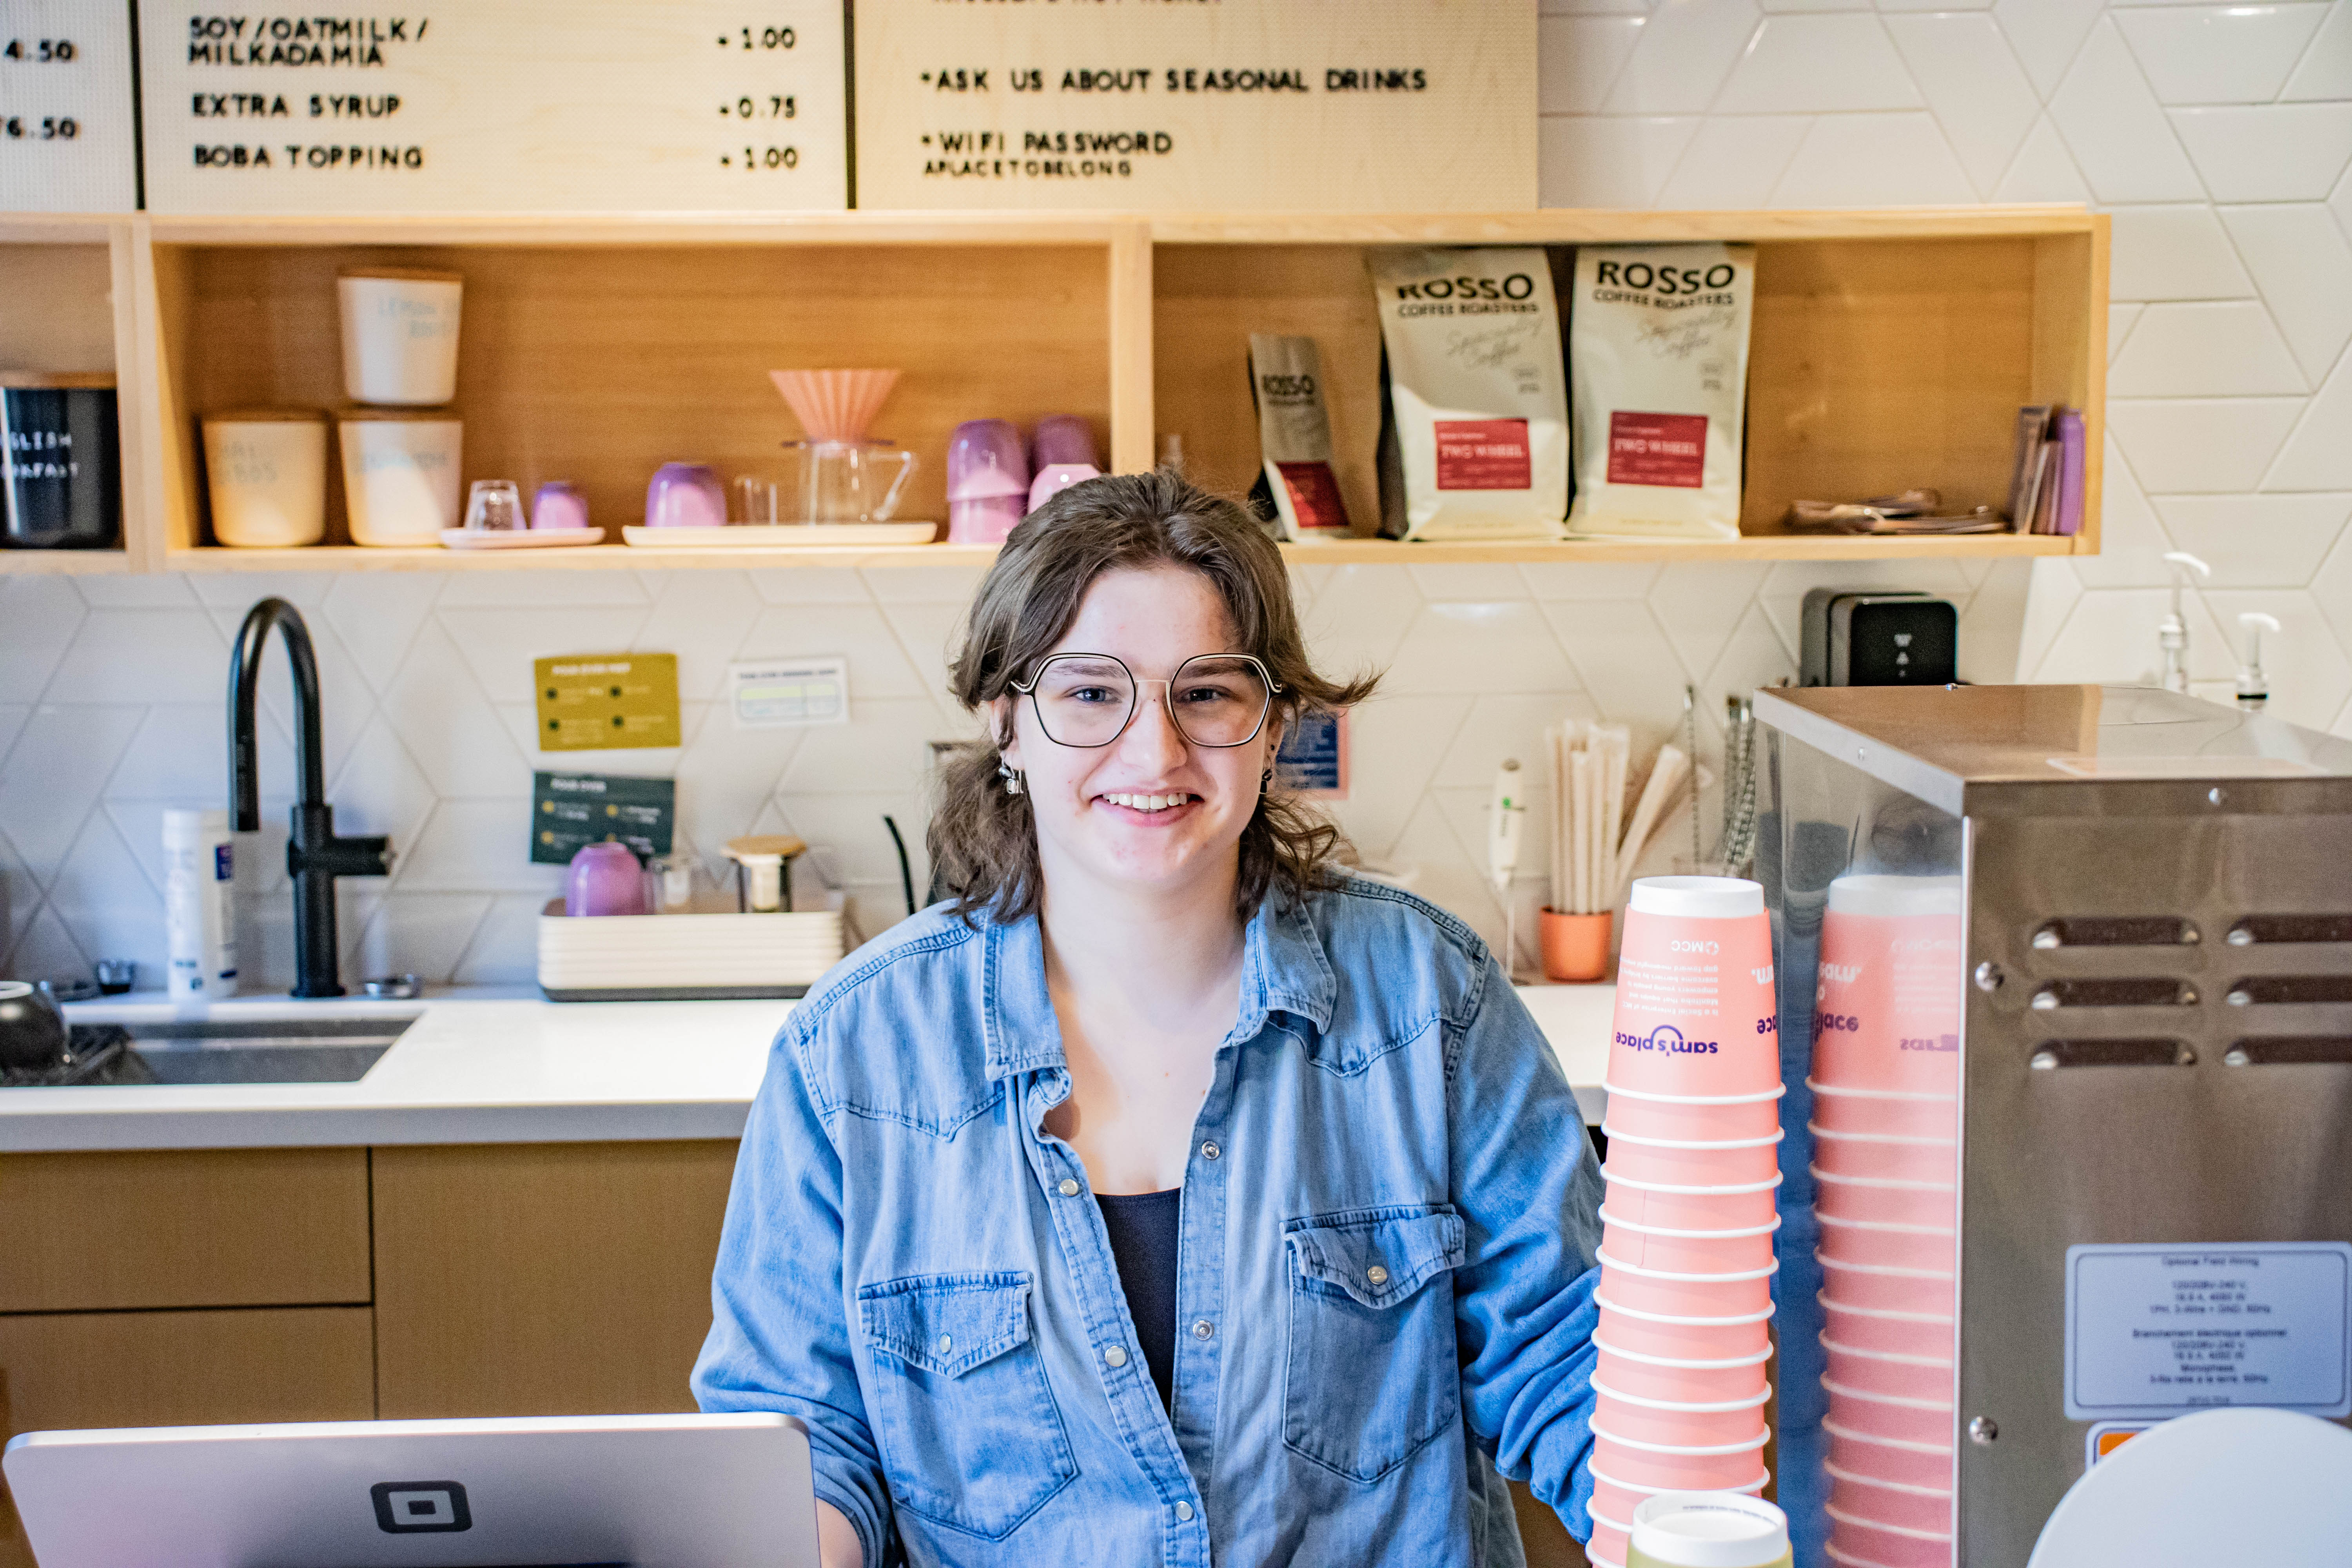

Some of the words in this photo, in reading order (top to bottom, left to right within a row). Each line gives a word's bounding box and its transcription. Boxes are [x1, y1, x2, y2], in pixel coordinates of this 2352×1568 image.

[189, 42, 384, 67] MILKADAMIA
[1011, 68, 1044, 91] US
[1062, 69, 1151, 92] ABOUT
[1165, 67, 1308, 92] SEASONAL
[1326, 68, 1427, 92] DRINKS
[192, 93, 289, 118] EXTRA
[309, 93, 401, 118] SYRUP
[0, 115, 80, 139] 6.50
[1024, 130, 1172, 154] PASSWORD
[194, 144, 270, 168] BOBA
[285, 144, 423, 169] TOPPING
[1595, 260, 1735, 295] ROSSO
[1671, 940, 1704, 953] MCC
